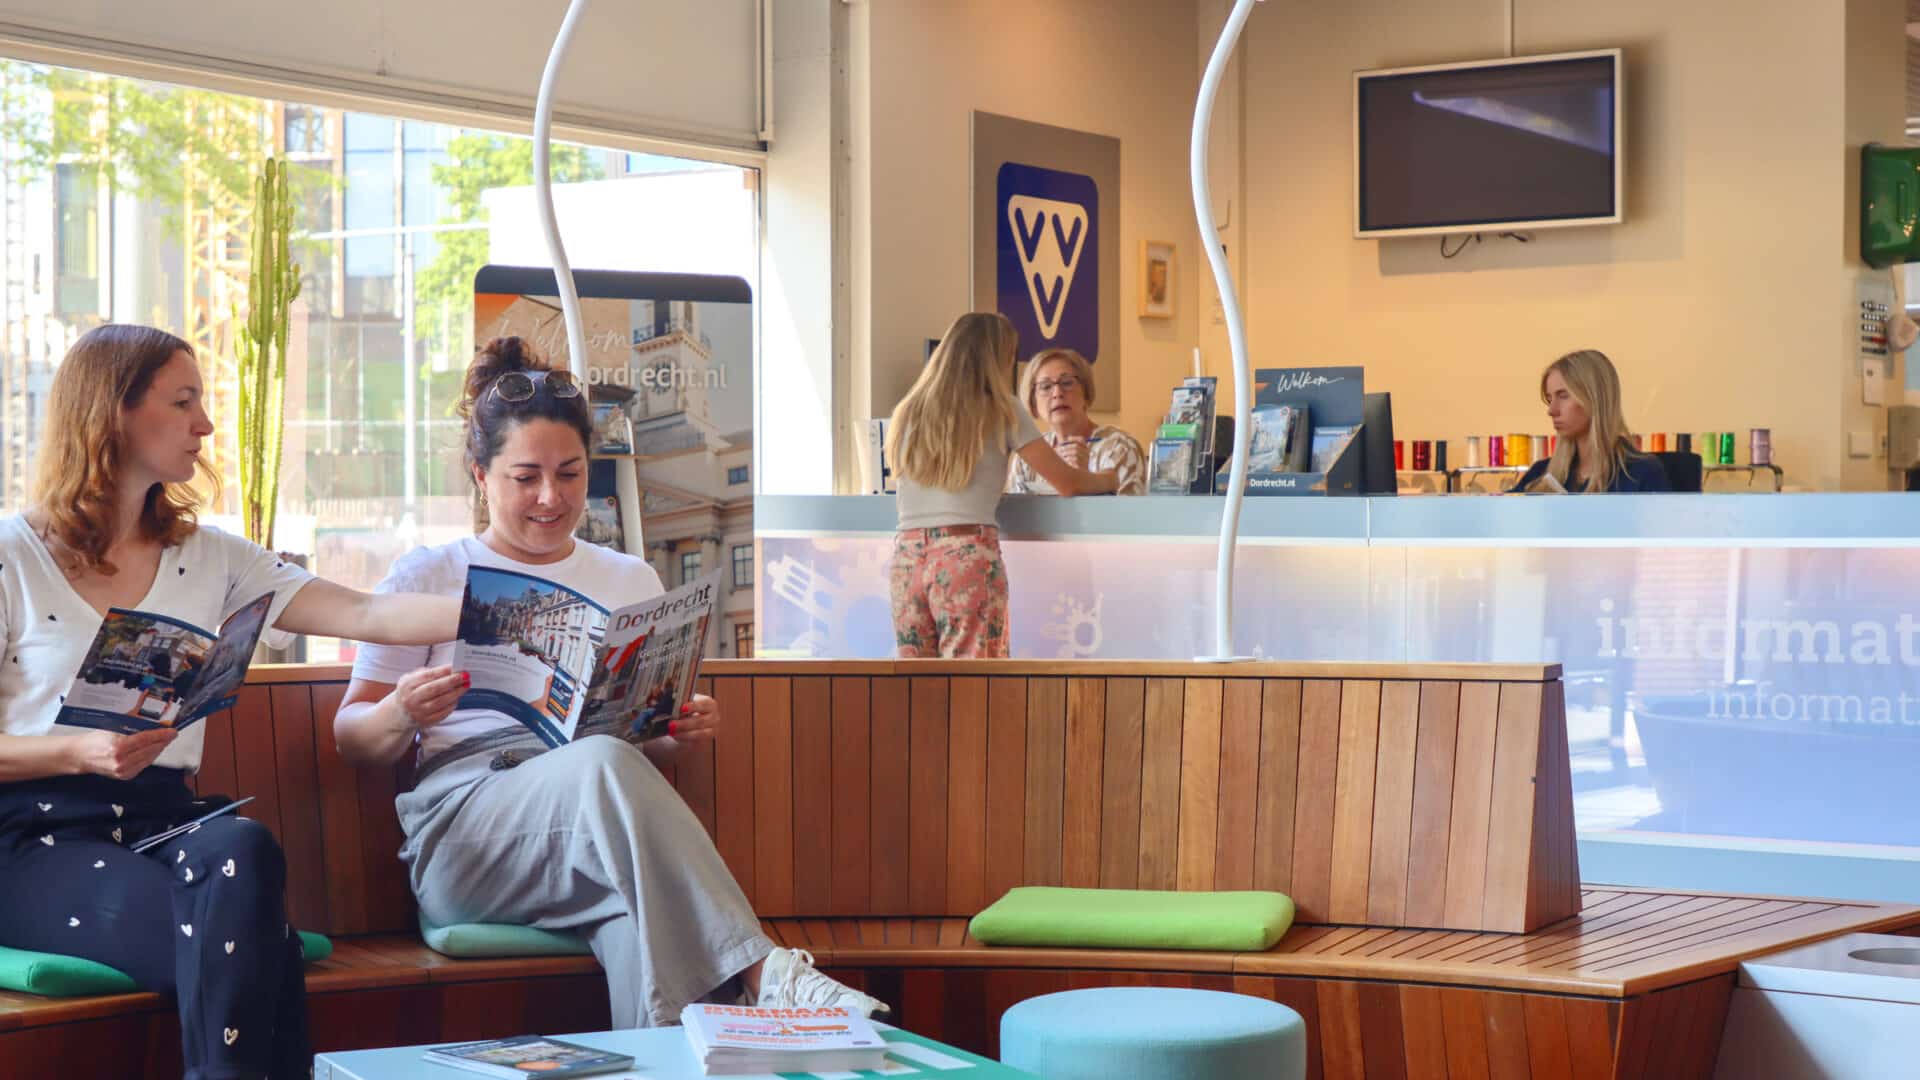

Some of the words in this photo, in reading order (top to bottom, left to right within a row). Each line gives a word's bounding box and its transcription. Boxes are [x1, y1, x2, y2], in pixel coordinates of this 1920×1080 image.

[584, 362, 727, 389] ordrecht.nl
[1249, 477, 1297, 489] Dordrecht.nl
[614, 583, 712, 632] Dordrecht
